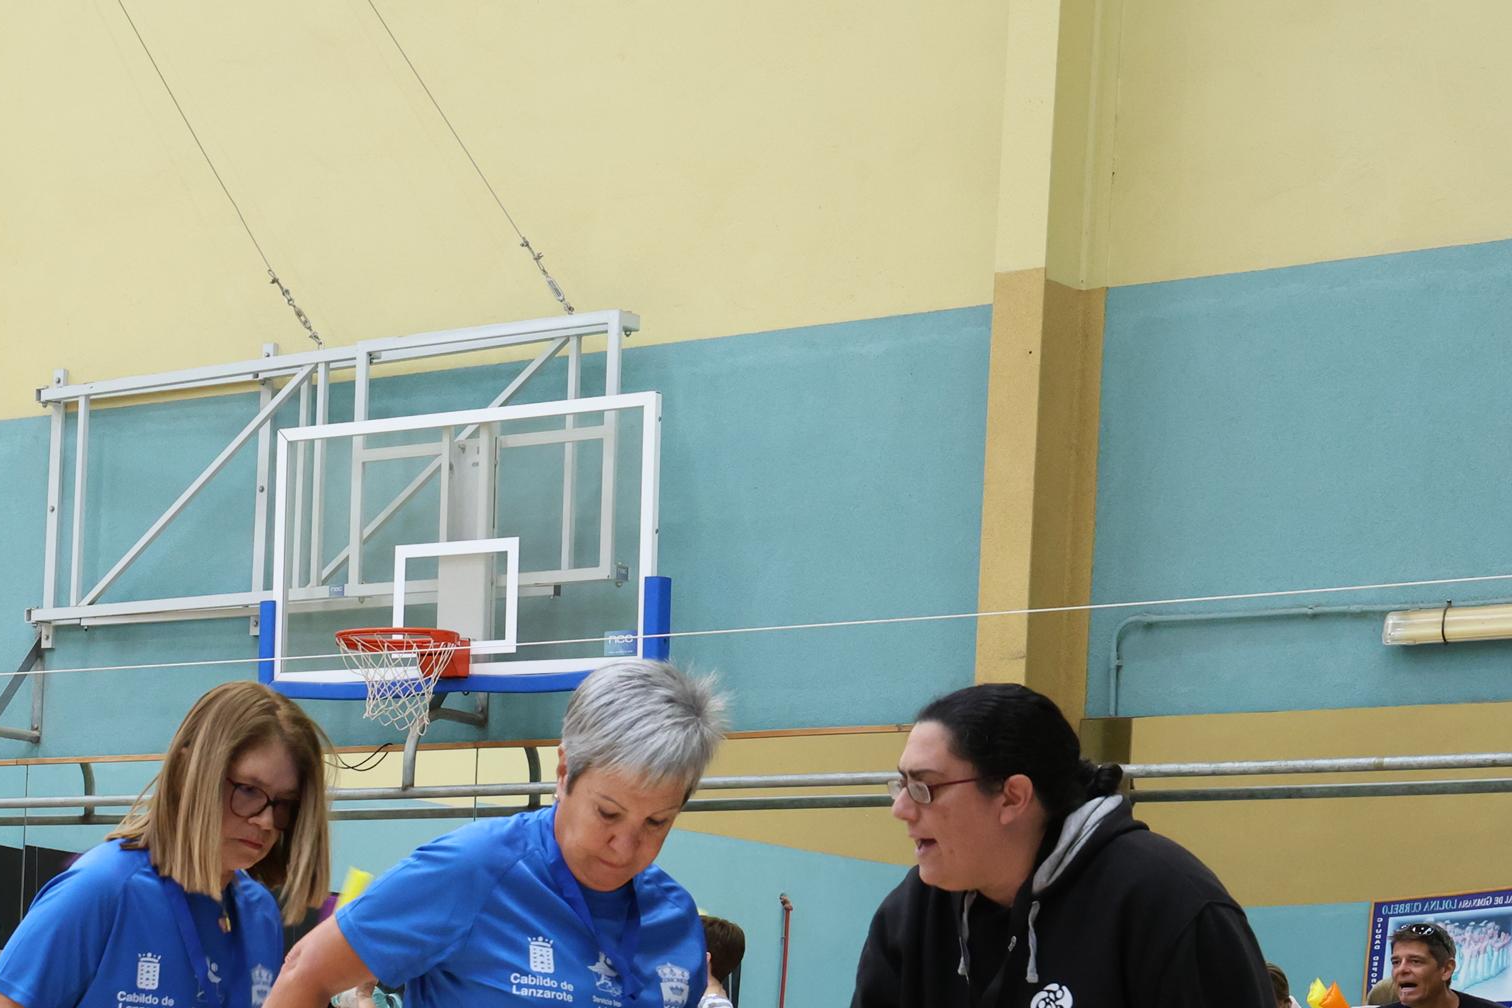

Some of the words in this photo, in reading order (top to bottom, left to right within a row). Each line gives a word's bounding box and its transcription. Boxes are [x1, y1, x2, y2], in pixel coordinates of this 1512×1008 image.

[510, 972, 558, 988] Cabildo
[560, 981, 574, 992] de
[116, 990, 158, 1006] Cabildo
[162, 996, 175, 1007] de
[512, 985, 574, 1002] Lanzarote
